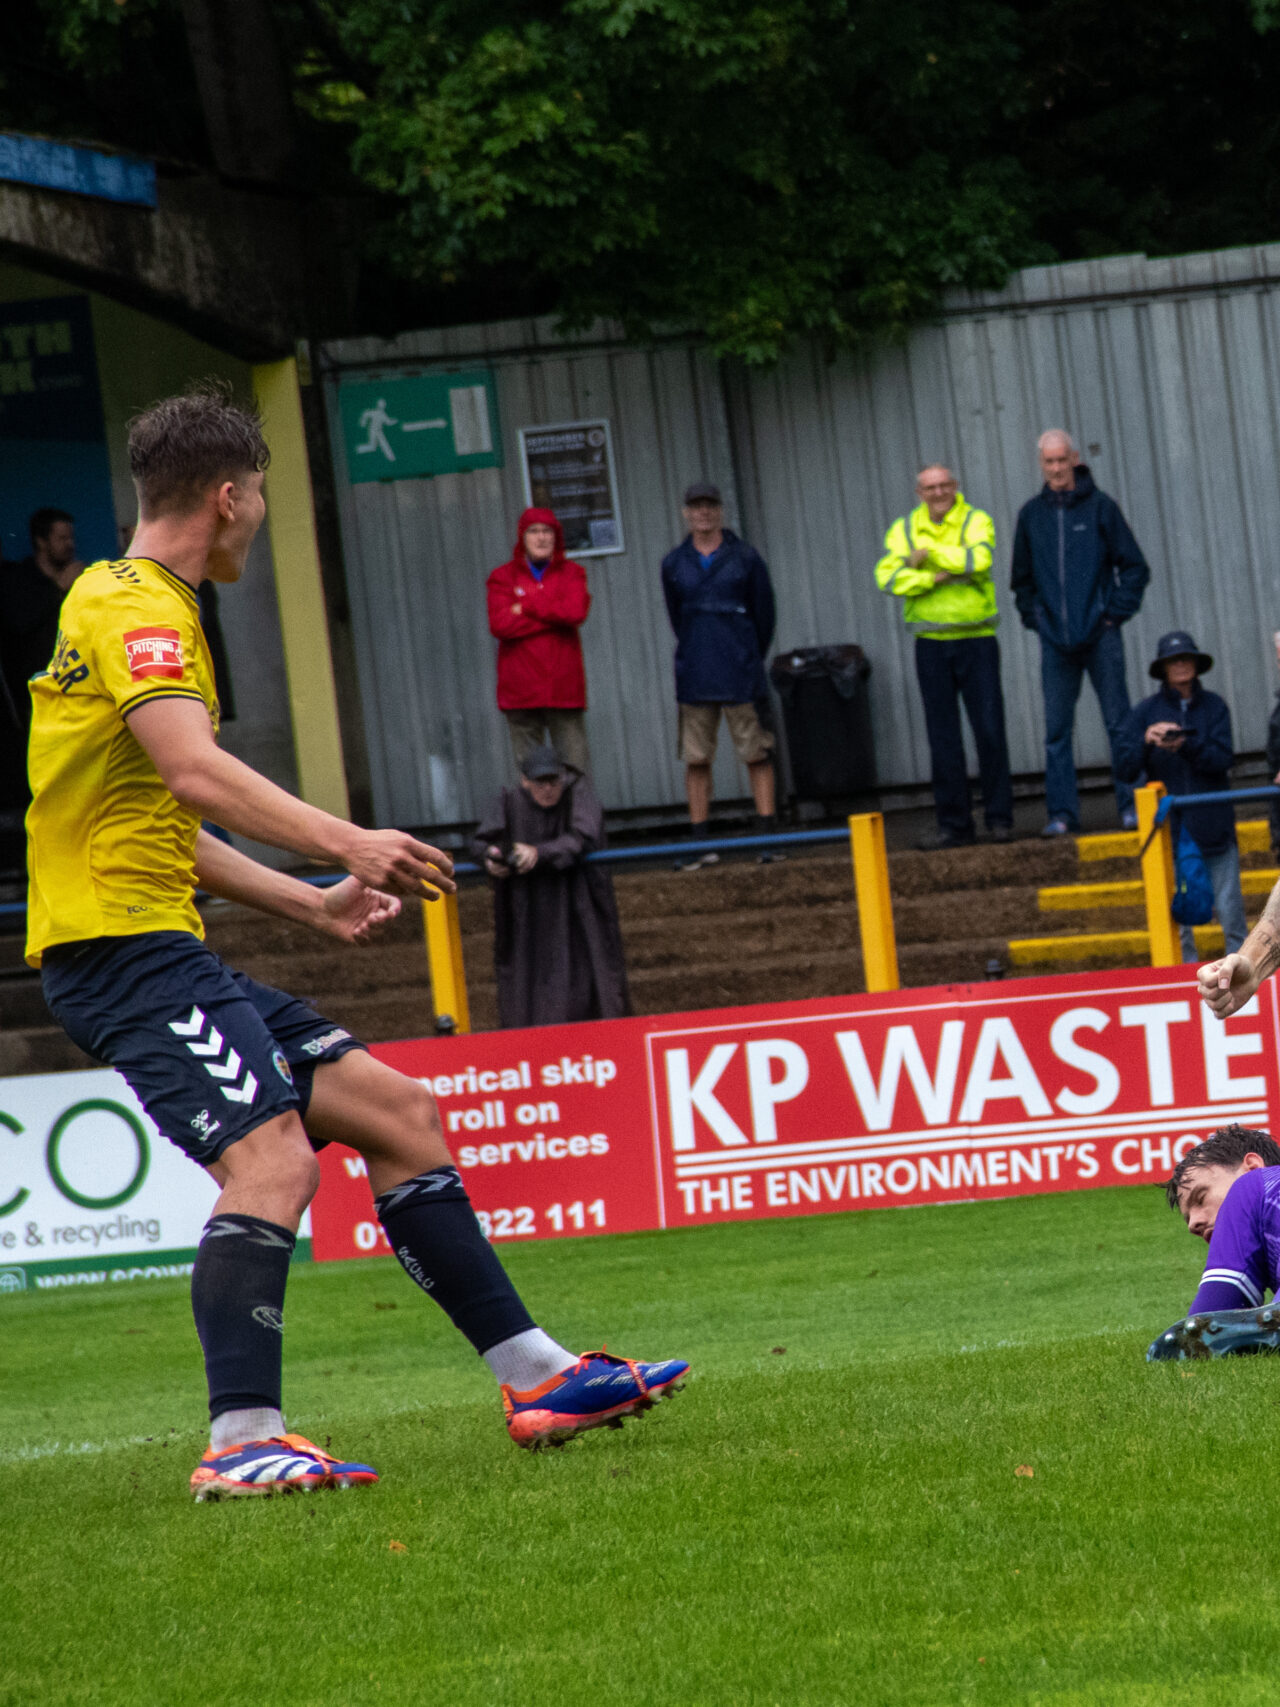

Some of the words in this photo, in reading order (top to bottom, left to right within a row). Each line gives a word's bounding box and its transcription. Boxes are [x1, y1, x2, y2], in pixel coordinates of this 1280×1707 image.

[132, 640, 174, 656] PITCHING
[153, 650, 164, 662] IN
[540, 1055, 617, 1088] skip
[665, 1039, 810, 1151] KP
[836, 994, 1268, 1131] WASTE
[448, 1101, 505, 1132] roll
[516, 1101, 559, 1125] on
[458, 1133, 610, 1168] services
[677, 1176, 753, 1215] THE
[767, 1142, 1099, 1208] ENVIRONMENT'S
[25, 1221, 43, 1247] &
[53, 1214, 161, 1247] recycling
[545, 1198, 606, 1233] 111
